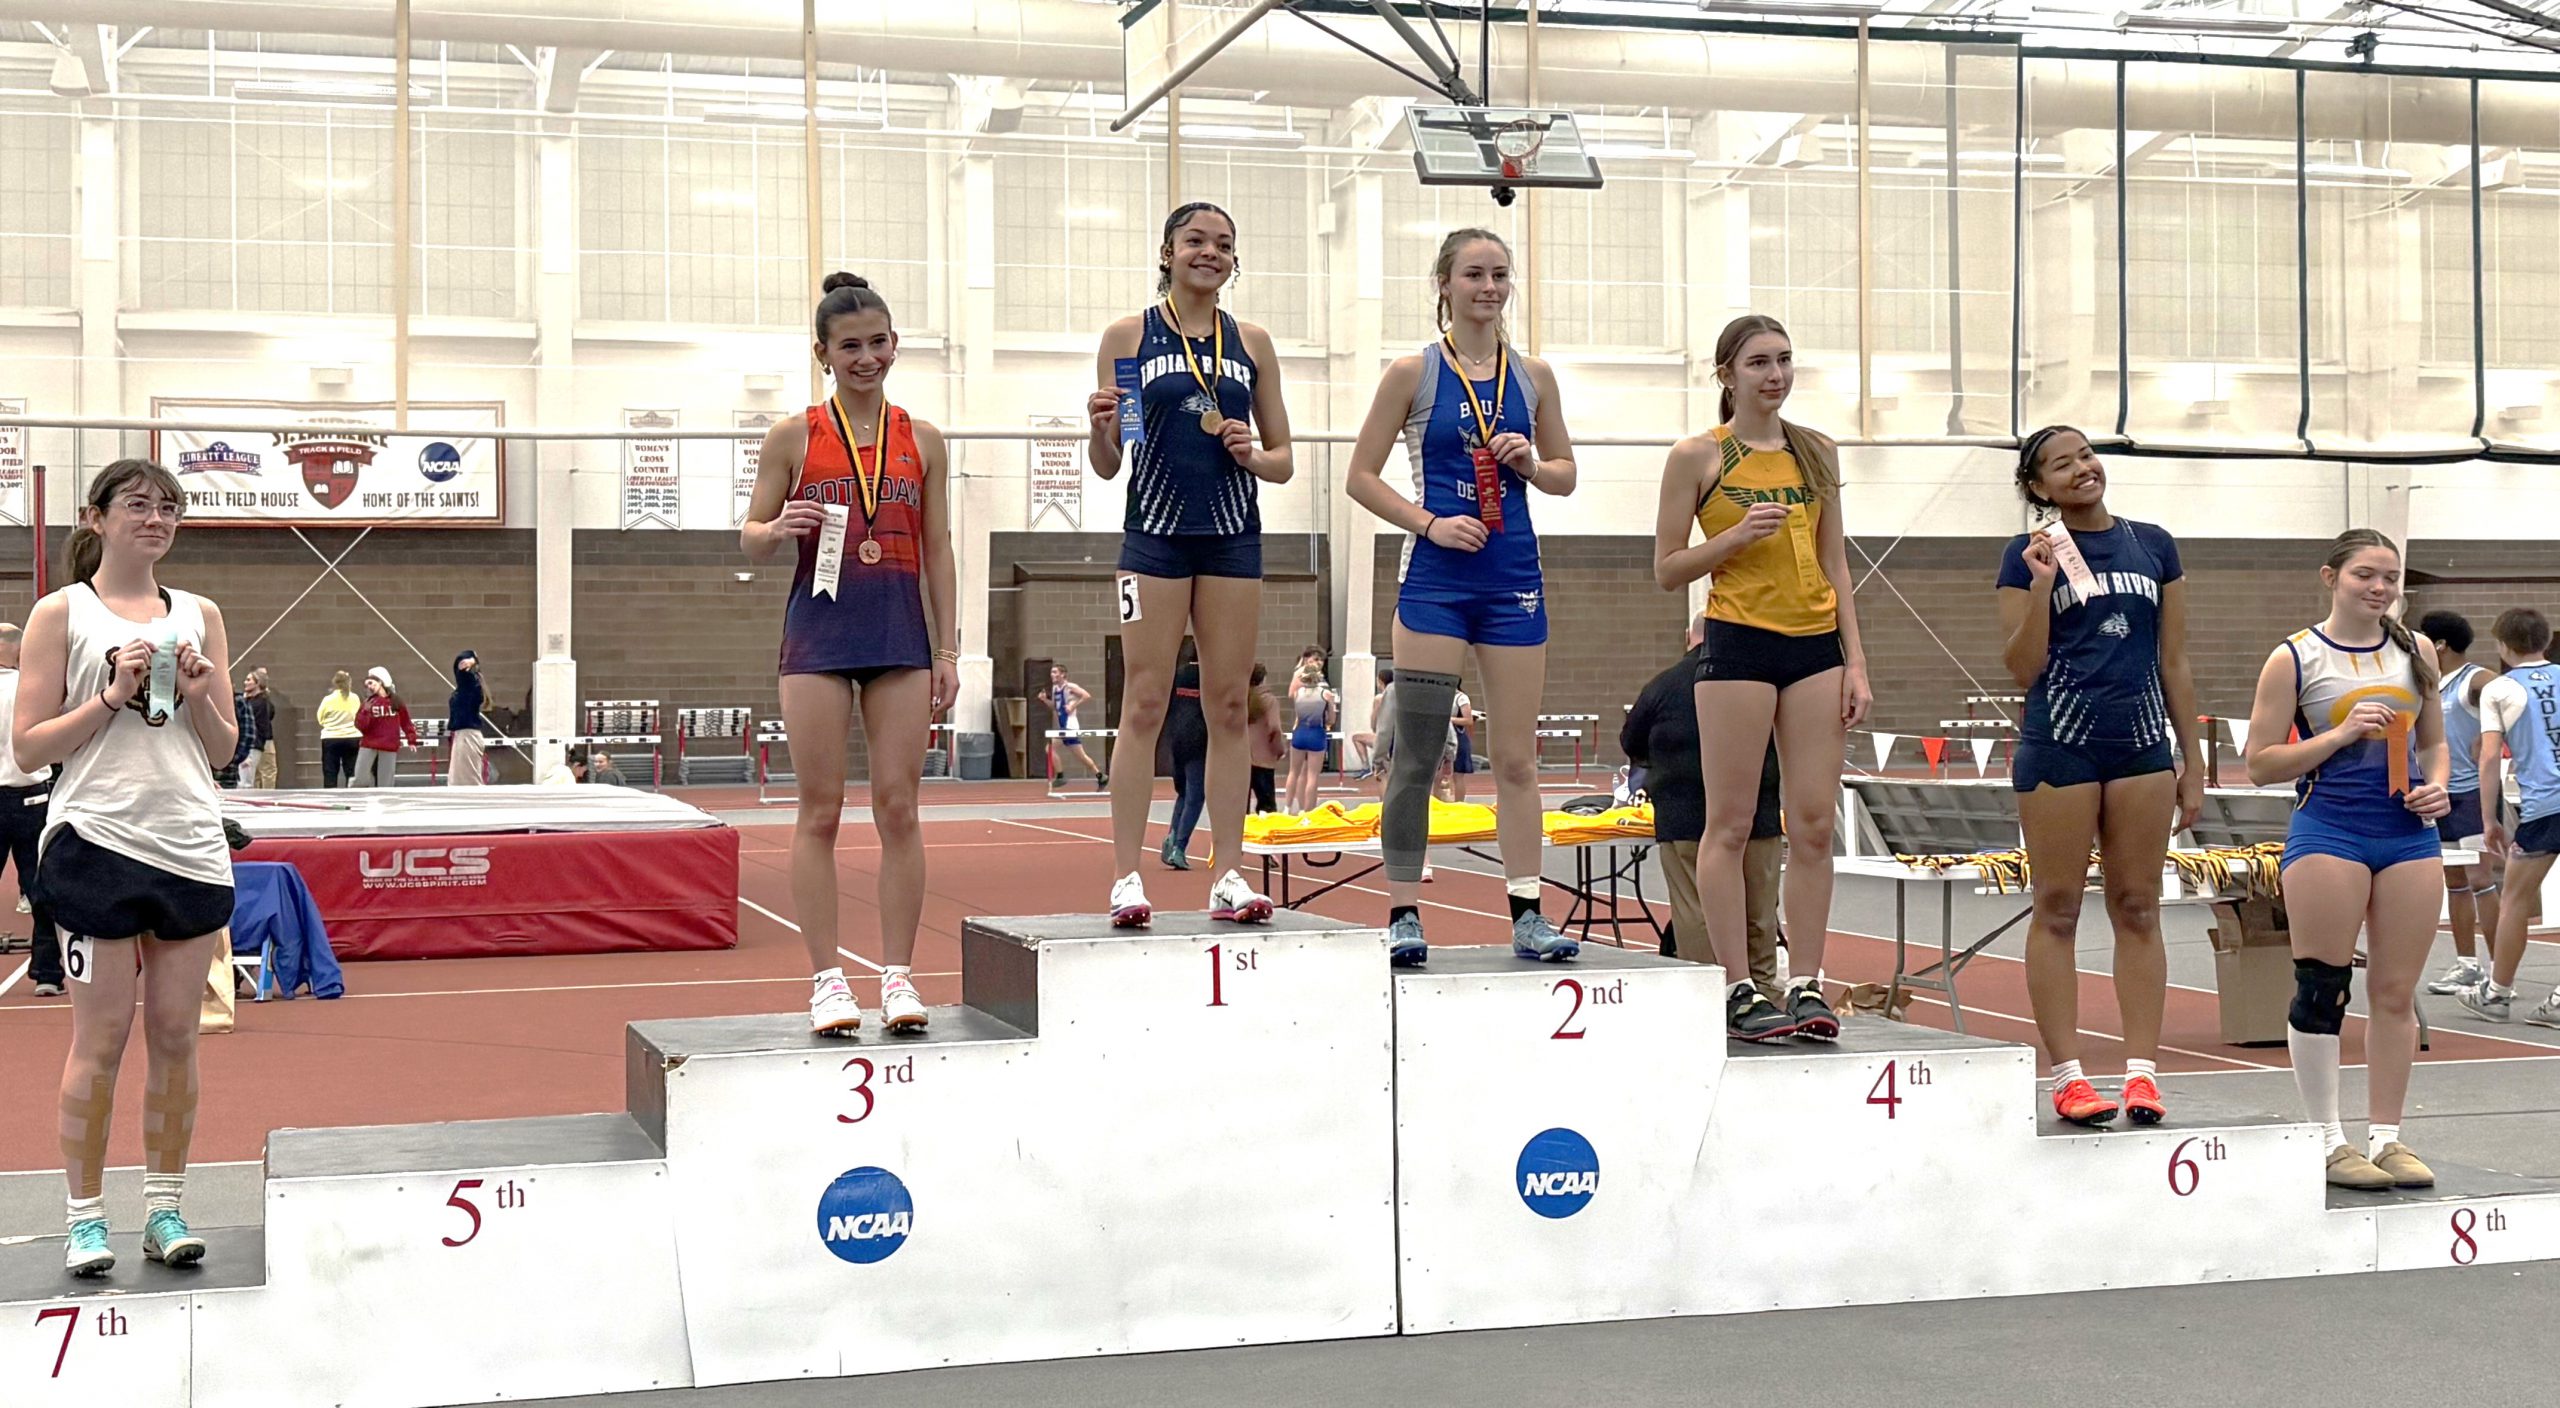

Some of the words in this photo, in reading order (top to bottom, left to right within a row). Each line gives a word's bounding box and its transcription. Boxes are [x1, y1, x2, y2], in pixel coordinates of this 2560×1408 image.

[1202, 355, 1250, 392] RVER
[1460, 400, 1504, 419] BUE
[181, 451, 219, 463] LIBERTY
[223, 451, 260, 464] LEAGUE
[299, 446, 328, 455] TRACK
[337, 446, 362, 455] FIELD
[422, 461, 461, 473] NCAA
[633, 466, 669, 474] COUNTRY
[184, 491, 220, 507] EWELL
[226, 492, 256, 507] FIELD
[261, 492, 299, 507] HOUSE
[363, 493, 392, 508] HOME
[397, 492, 410, 508] OF
[414, 492, 435, 508] THE
[439, 491, 479, 508] SAINTS!
[1457, 480, 1507, 501] DES
[1121, 578, 1134, 621] 5
[2111, 572, 2159, 607] RIVER
[2531, 684, 2560, 771] WOLVE
[359, 847, 490, 877] UCS
[67, 935, 84, 978] 6
[1204, 943, 1259, 1007] 1st
[1550, 978, 1623, 1040] 2nd
[836, 1055, 915, 1124] 3rd
[1866, 1059, 1932, 1119] 4th
[2168, 1135, 2227, 1196] 6th
[1524, 1171, 1597, 1197] NCAA
[441, 1178, 525, 1247] 5th
[827, 1211, 911, 1242] NCAA
[2450, 1207, 2507, 1265] 8th
[34, 1305, 129, 1378] 7th
